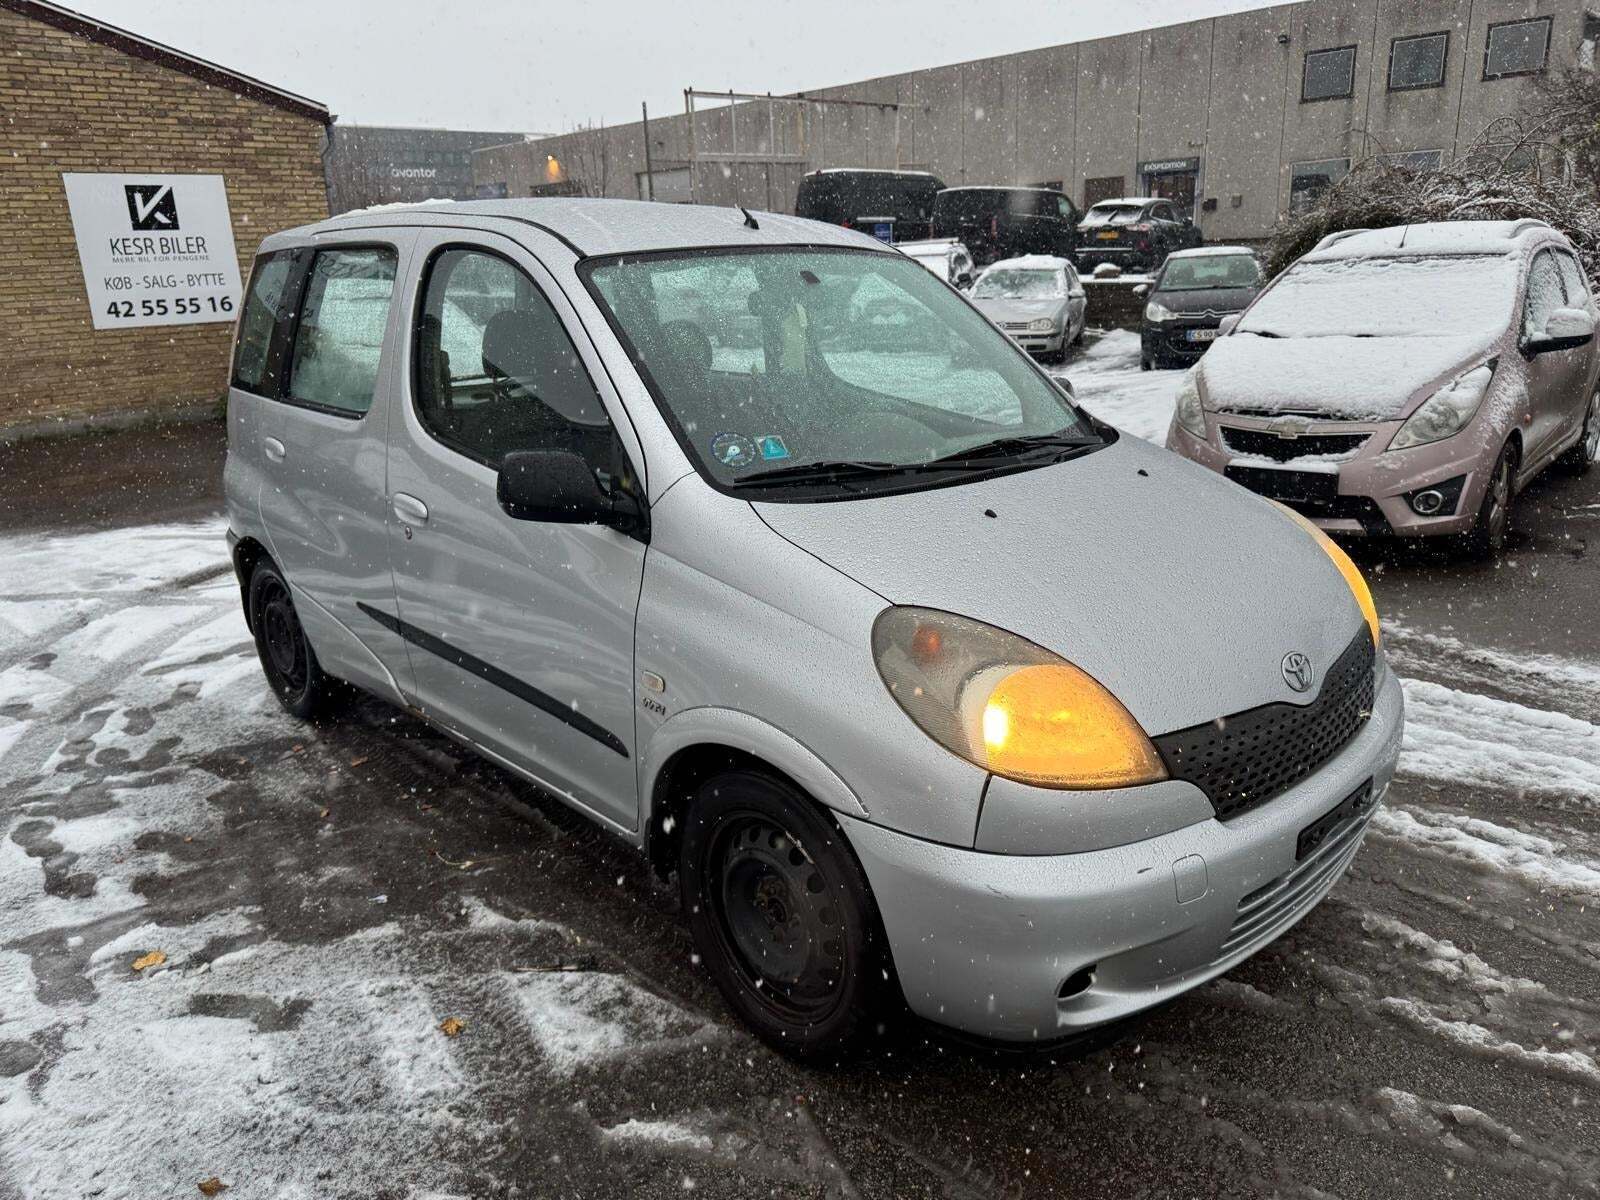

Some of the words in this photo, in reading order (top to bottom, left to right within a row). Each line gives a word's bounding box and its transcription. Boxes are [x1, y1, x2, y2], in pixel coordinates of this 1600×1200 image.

[110, 238, 155, 256] KESR
[159, 237, 208, 255] BILER
[112, 256, 136, 264] MERE
[173, 254, 210, 262] PENGENE
[104, 276, 132, 291] KØB
[144, 275, 177, 289] SALG
[187, 273, 226, 287] BYTTE
[107, 301, 136, 318] 42
[142, 299, 168, 316] 55
[175, 298, 201, 314] 55
[207, 296, 233, 313] 16
